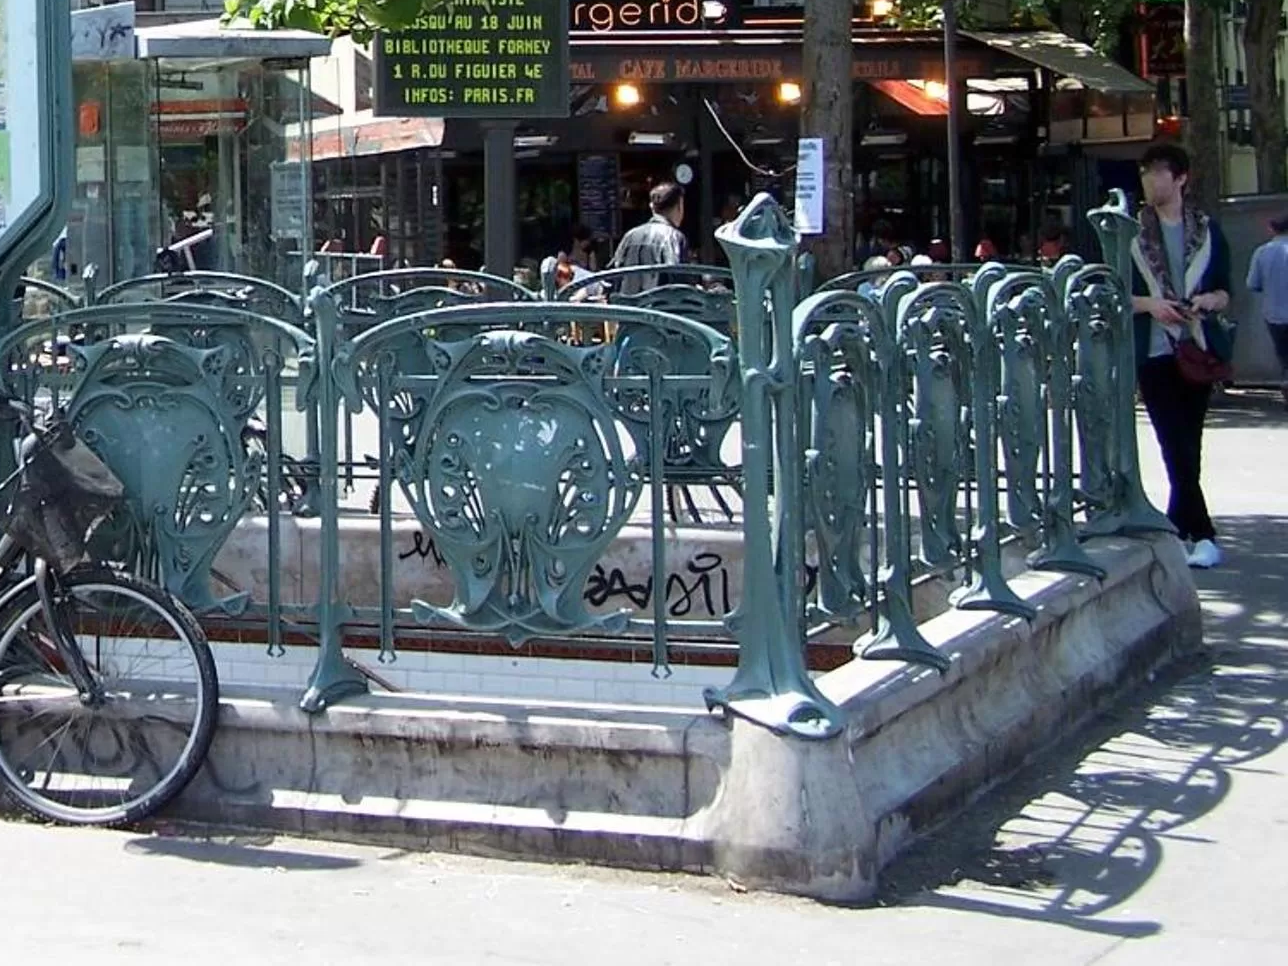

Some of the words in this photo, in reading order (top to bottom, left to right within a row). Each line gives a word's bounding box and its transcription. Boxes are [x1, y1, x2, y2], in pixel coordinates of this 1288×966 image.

[480, 15, 499, 30] 18
[507, 15, 543, 30] JUIN
[384, 39, 490, 55] BIBLIOTHEQUE
[498, 39, 551, 55] FORNEY
[393, 64, 403, 79] 1
[455, 64, 516, 79] FIGUIER
[525, 64, 543, 79] 4E
[405, 87, 455, 104] INFOS:
[464, 87, 535, 104] PARIS.FR
